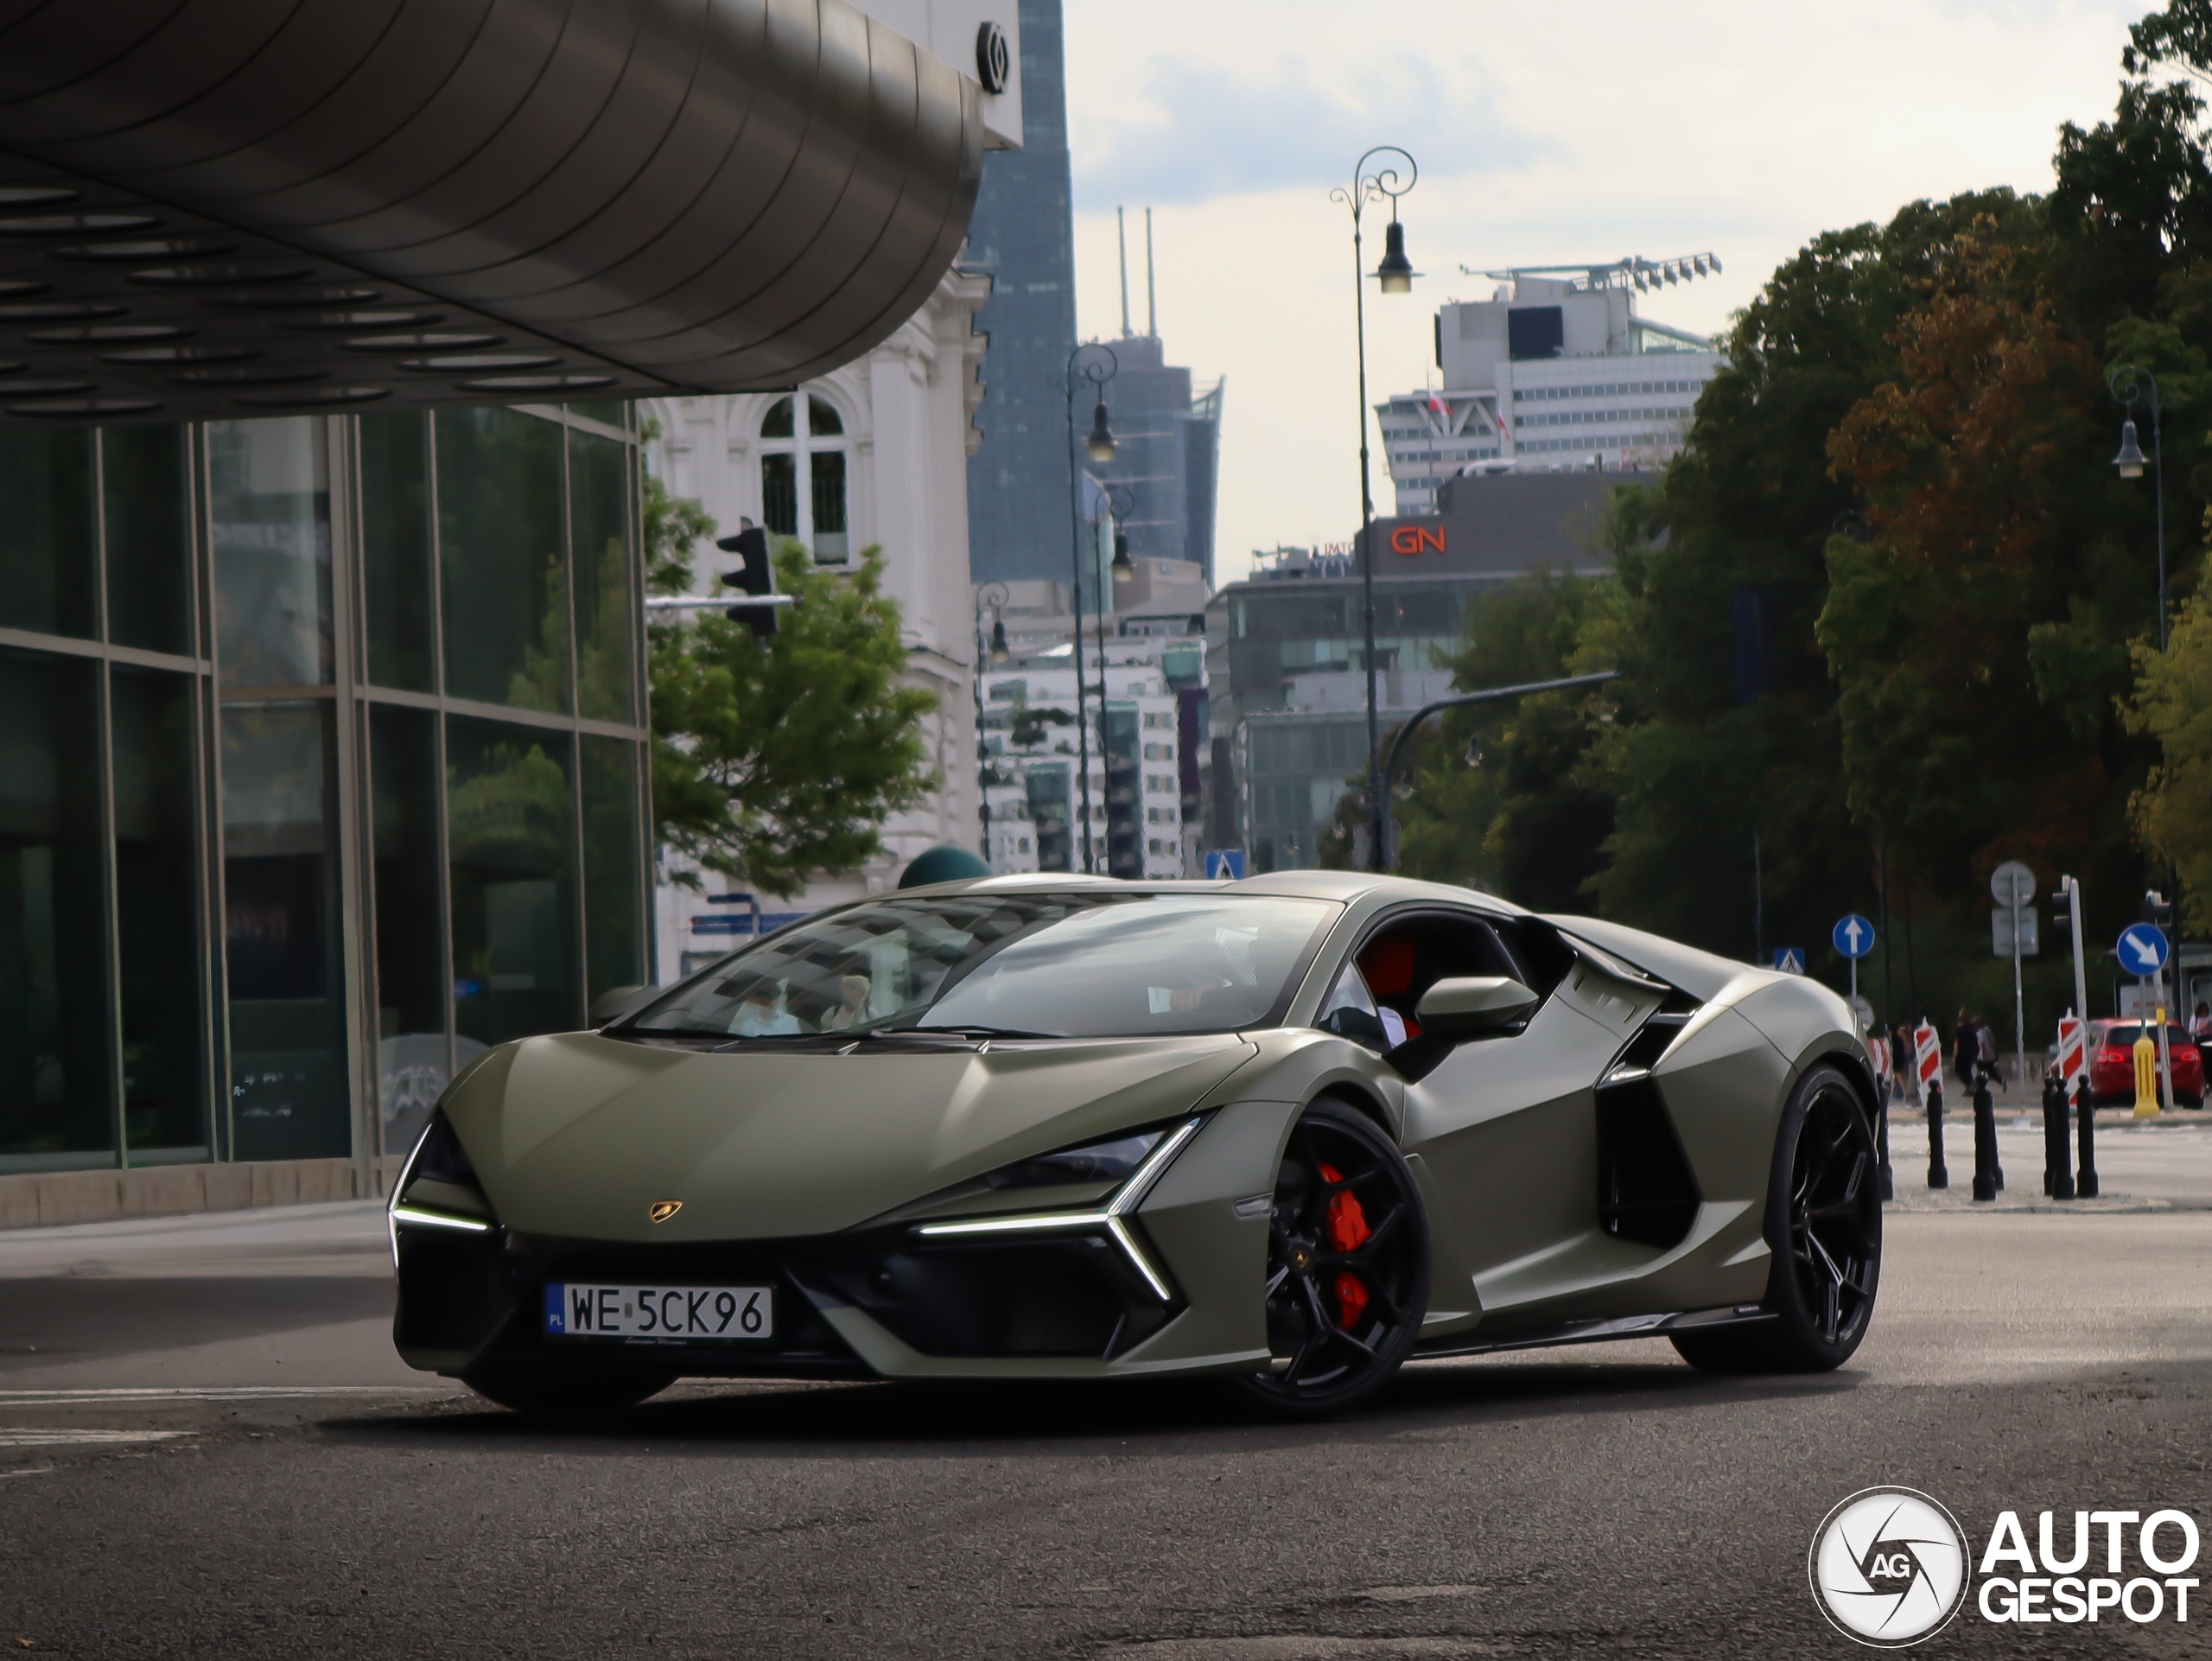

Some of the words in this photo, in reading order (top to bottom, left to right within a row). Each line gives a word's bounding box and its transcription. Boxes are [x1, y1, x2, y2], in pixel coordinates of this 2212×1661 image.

[1391, 525, 1445, 554] GN
[550, 1314, 563, 1326] PL
[572, 1289, 620, 1331] WE
[638, 1290, 763, 1333] 5CK96
